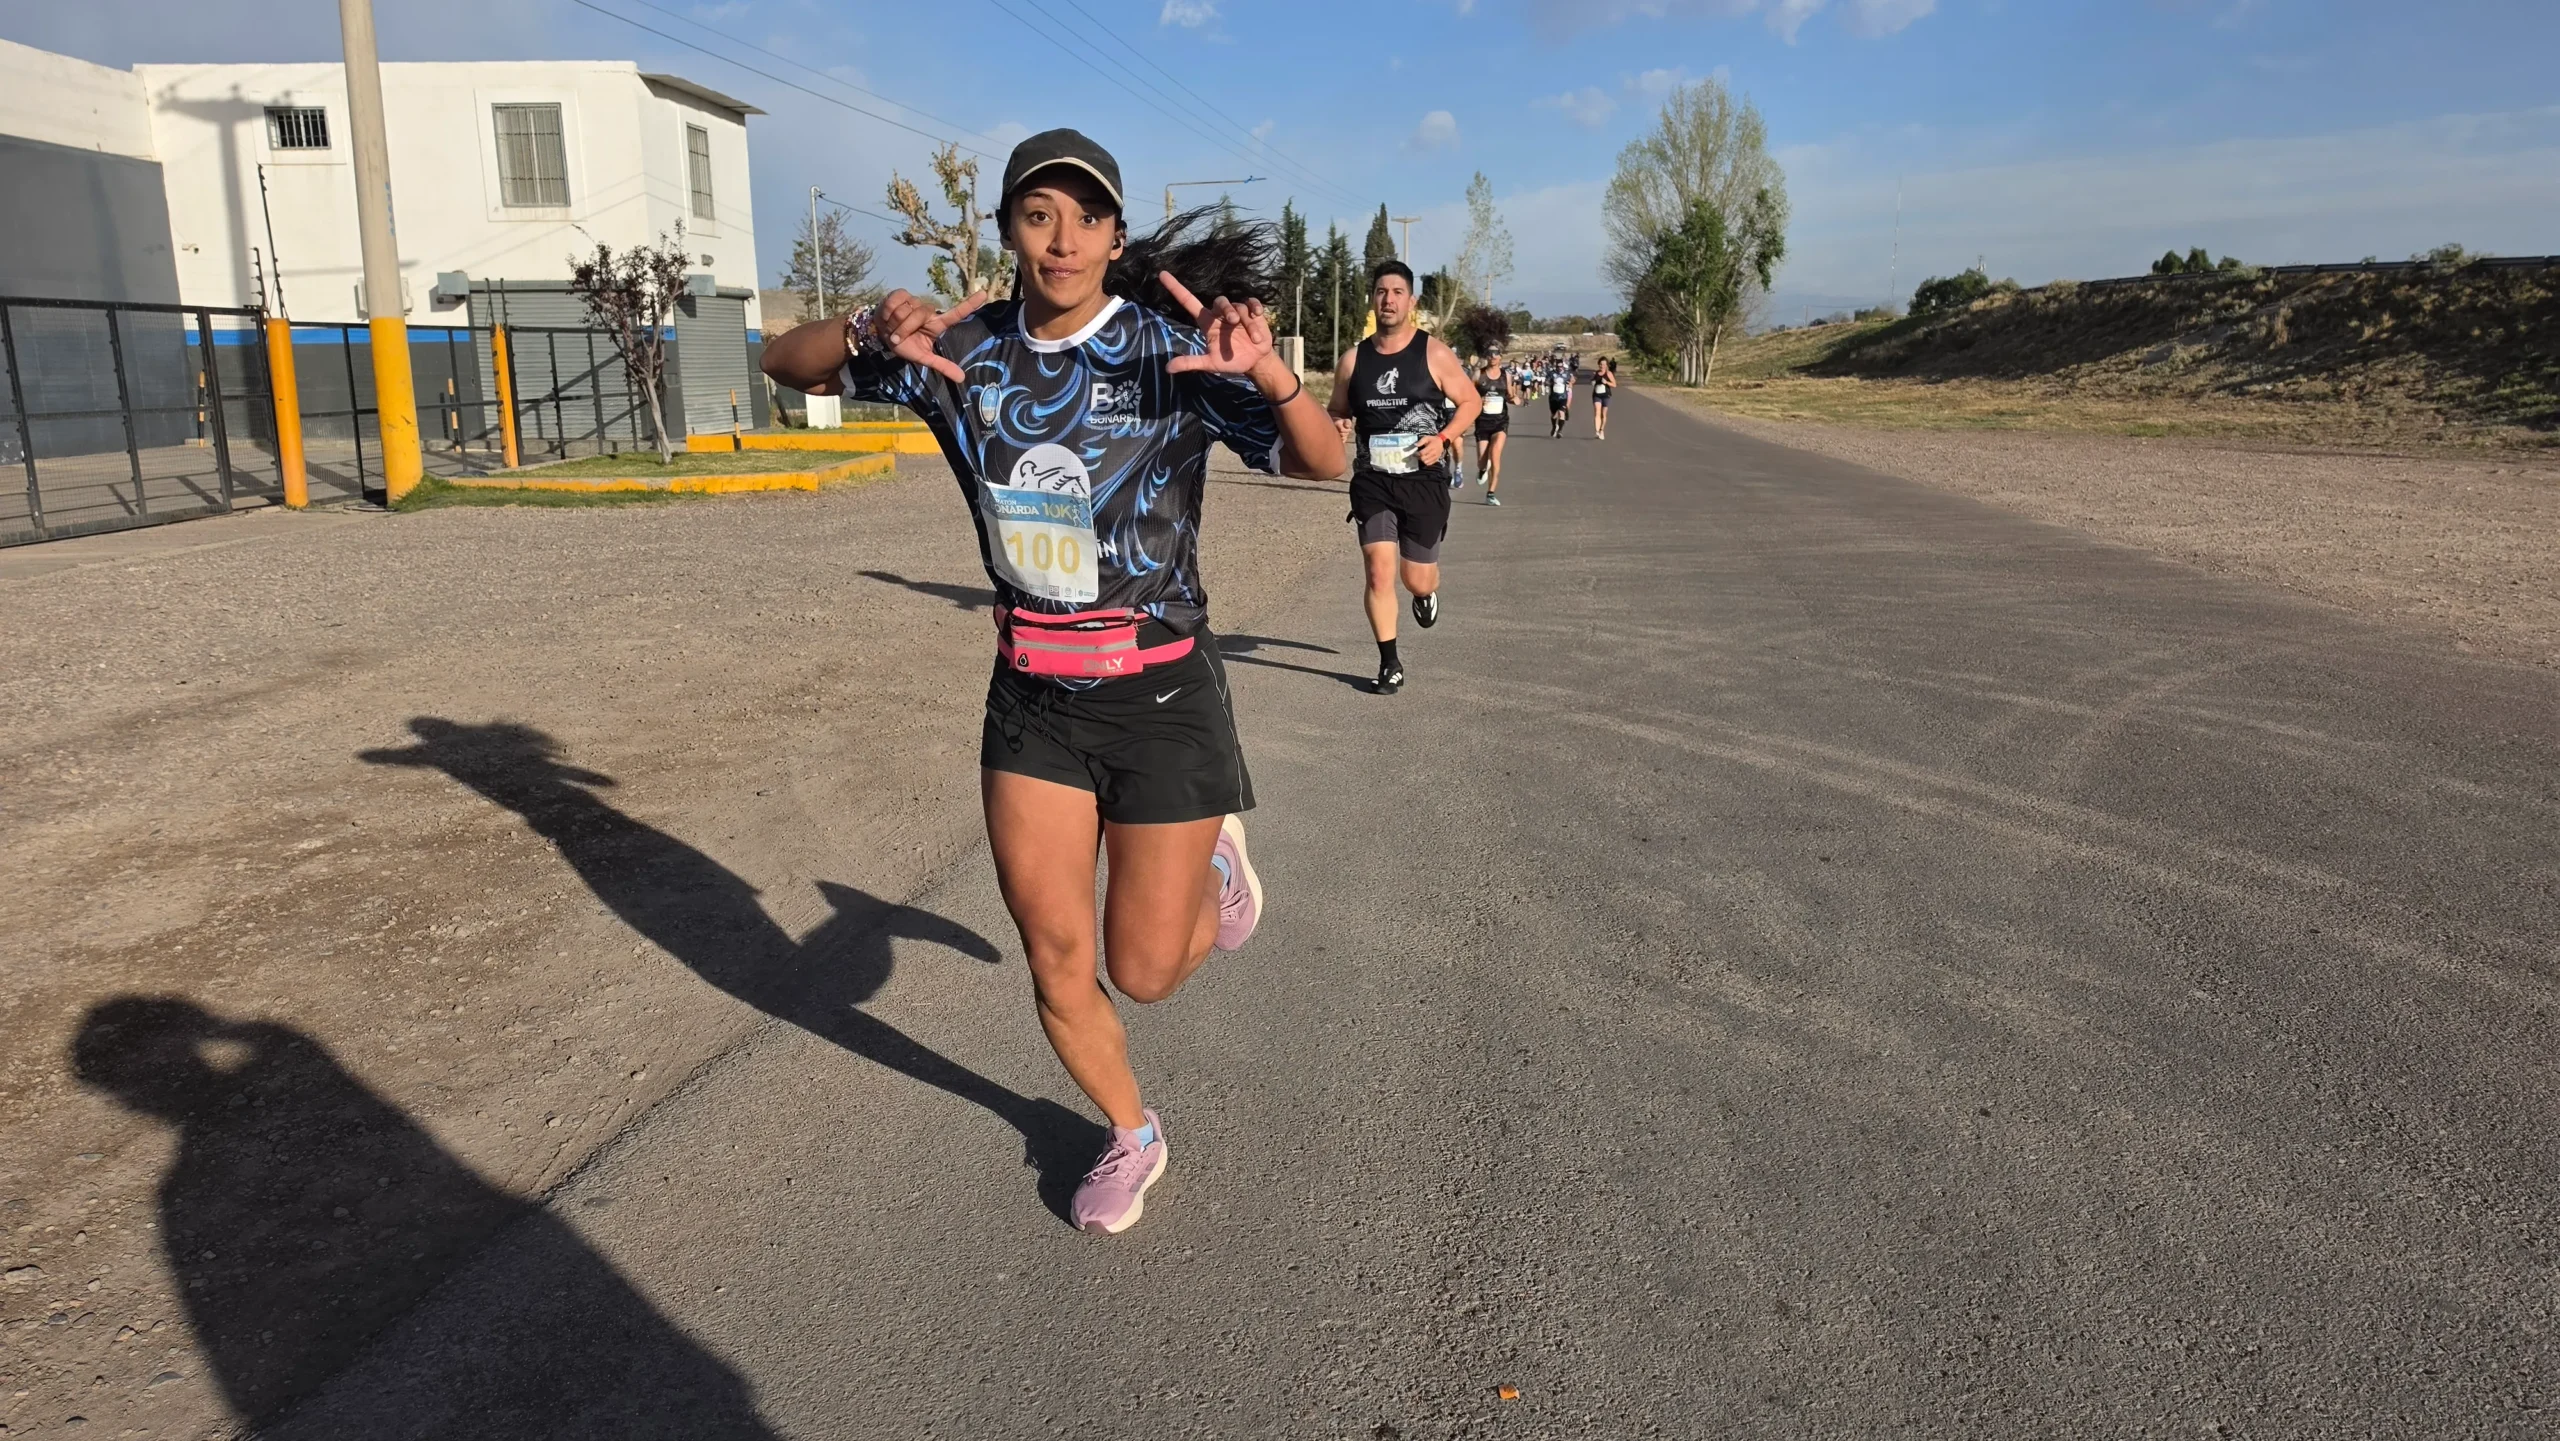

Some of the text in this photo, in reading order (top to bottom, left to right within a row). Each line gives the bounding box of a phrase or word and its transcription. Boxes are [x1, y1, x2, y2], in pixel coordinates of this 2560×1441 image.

[1366, 398, 1408, 407] PROACTIVE
[1091, 413, 1141, 424] BONARDA
[994, 502, 1072, 519] ONARDA 10K
[1006, 532, 1080, 574] 100
